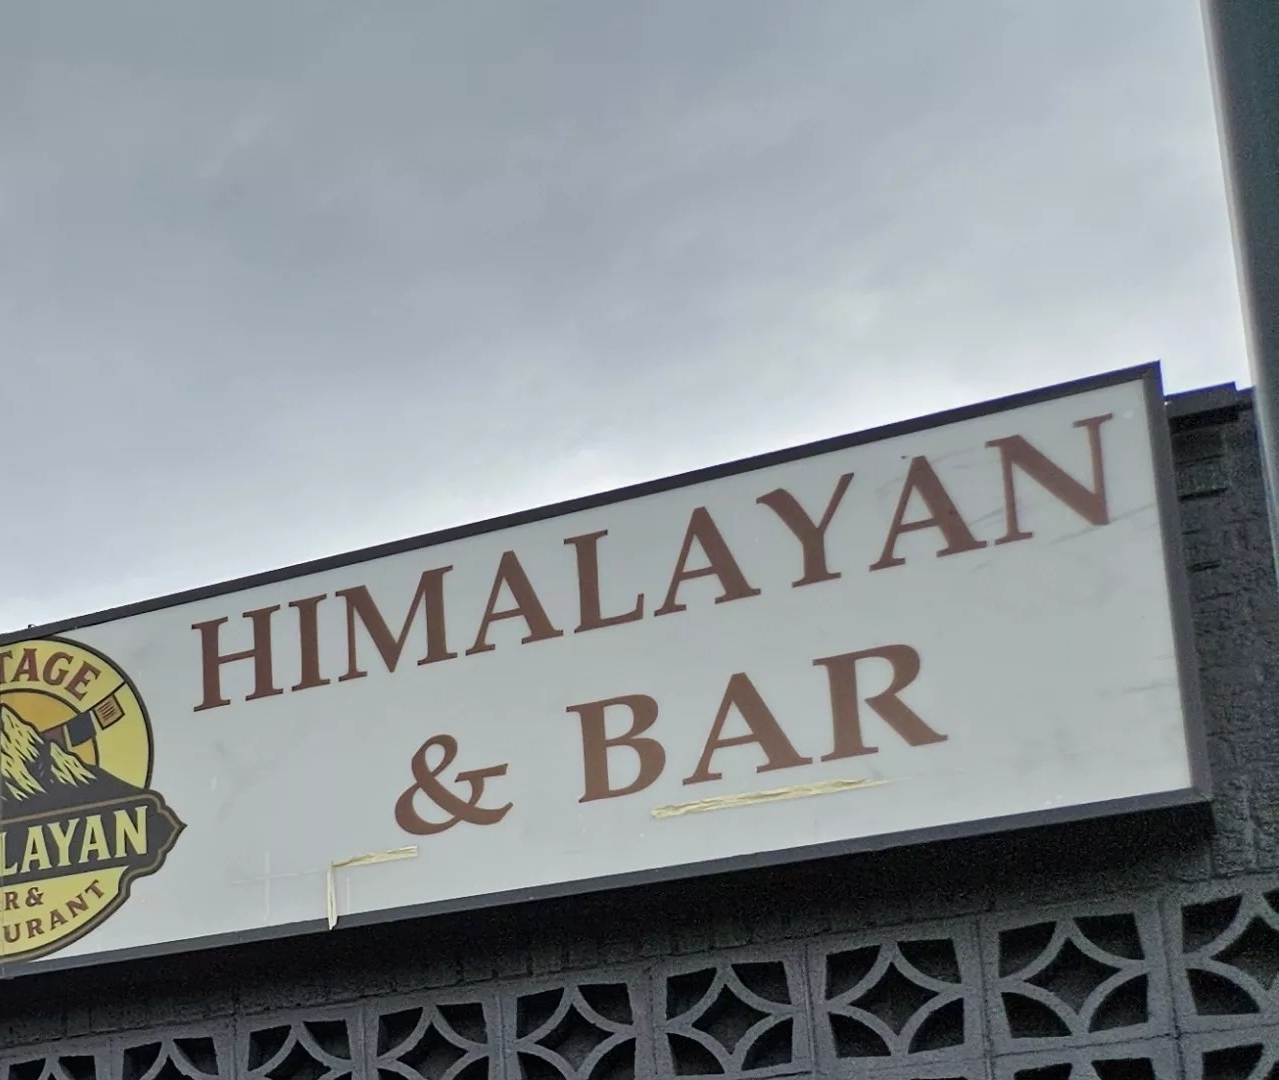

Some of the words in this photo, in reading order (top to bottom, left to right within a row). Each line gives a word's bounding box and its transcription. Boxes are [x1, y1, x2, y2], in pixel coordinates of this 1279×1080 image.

[191, 413, 1113, 713] HIMALAYAN
[393, 733, 514, 837] &
[565, 643, 948, 803] BAR
